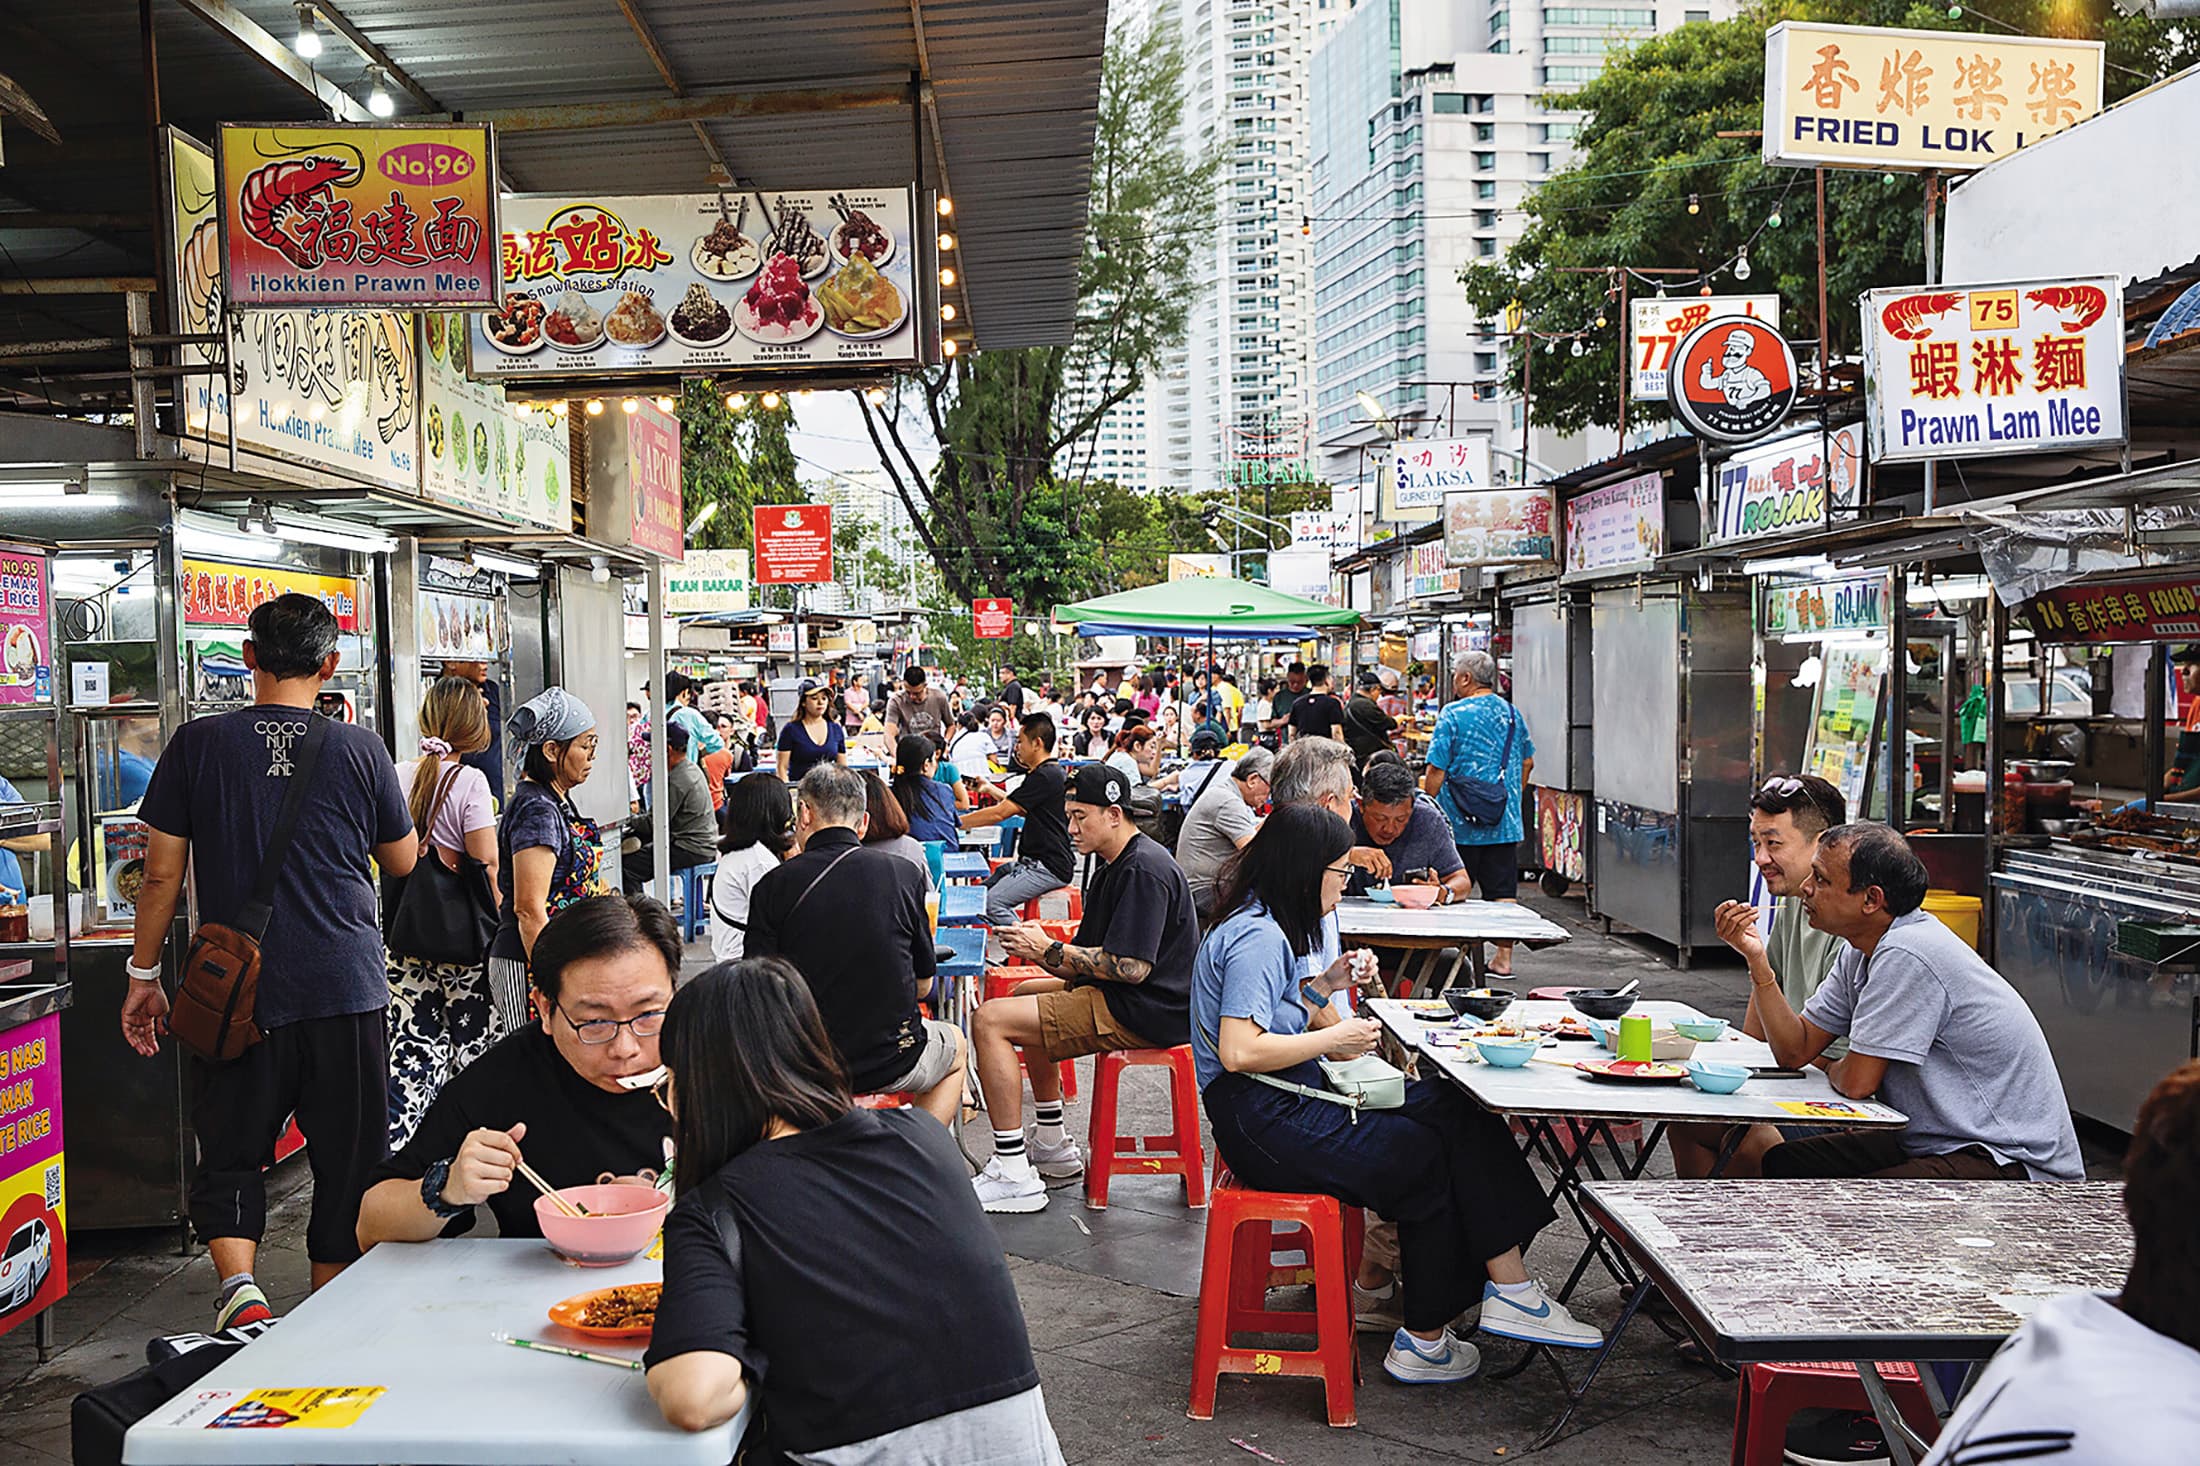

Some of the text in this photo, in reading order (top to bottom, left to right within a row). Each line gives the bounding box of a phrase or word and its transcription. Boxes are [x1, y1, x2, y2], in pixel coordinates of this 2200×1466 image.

[1794, 115, 1899, 147] FRIED
[1921, 125, 1995, 154] LOK
[386, 154, 470, 176] No.96
[251, 273, 480, 293] Hokkien Prawn Mee
[527, 278, 655, 300] Snowflakes Station
[1976, 299, 2013, 321] 75
[1638, 335, 1677, 371] 77
[1644, 381, 1665, 391] BEST
[1728, 386, 1743, 401] 77
[1901, 398, 2101, 446] Prawn Lam Mee
[353, 433, 374, 460] Mee
[1237, 440, 1295, 454] PONDOK
[645, 444, 679, 495] APOM
[1409, 470, 1474, 488] LAKSA
[1722, 465, 1748, 538] 77
[1742, 487, 1824, 535] ROJAK
[2, 560, 38, 577] NO.95
[670, 579, 743, 592] IKAN BAKAR
[9, 591, 39, 606] RICE
[336, 592, 352, 614] Mee
[1834, 583, 1879, 625] ROJAK
[2148, 586, 2196, 617] FRIED
[254, 720, 308, 736] COCO
[266, 735, 295, 749] NUT
[272, 748, 290, 763] ISL
[11, 1038, 46, 1076] NASI
[18, 1107, 51, 1147] RICE
